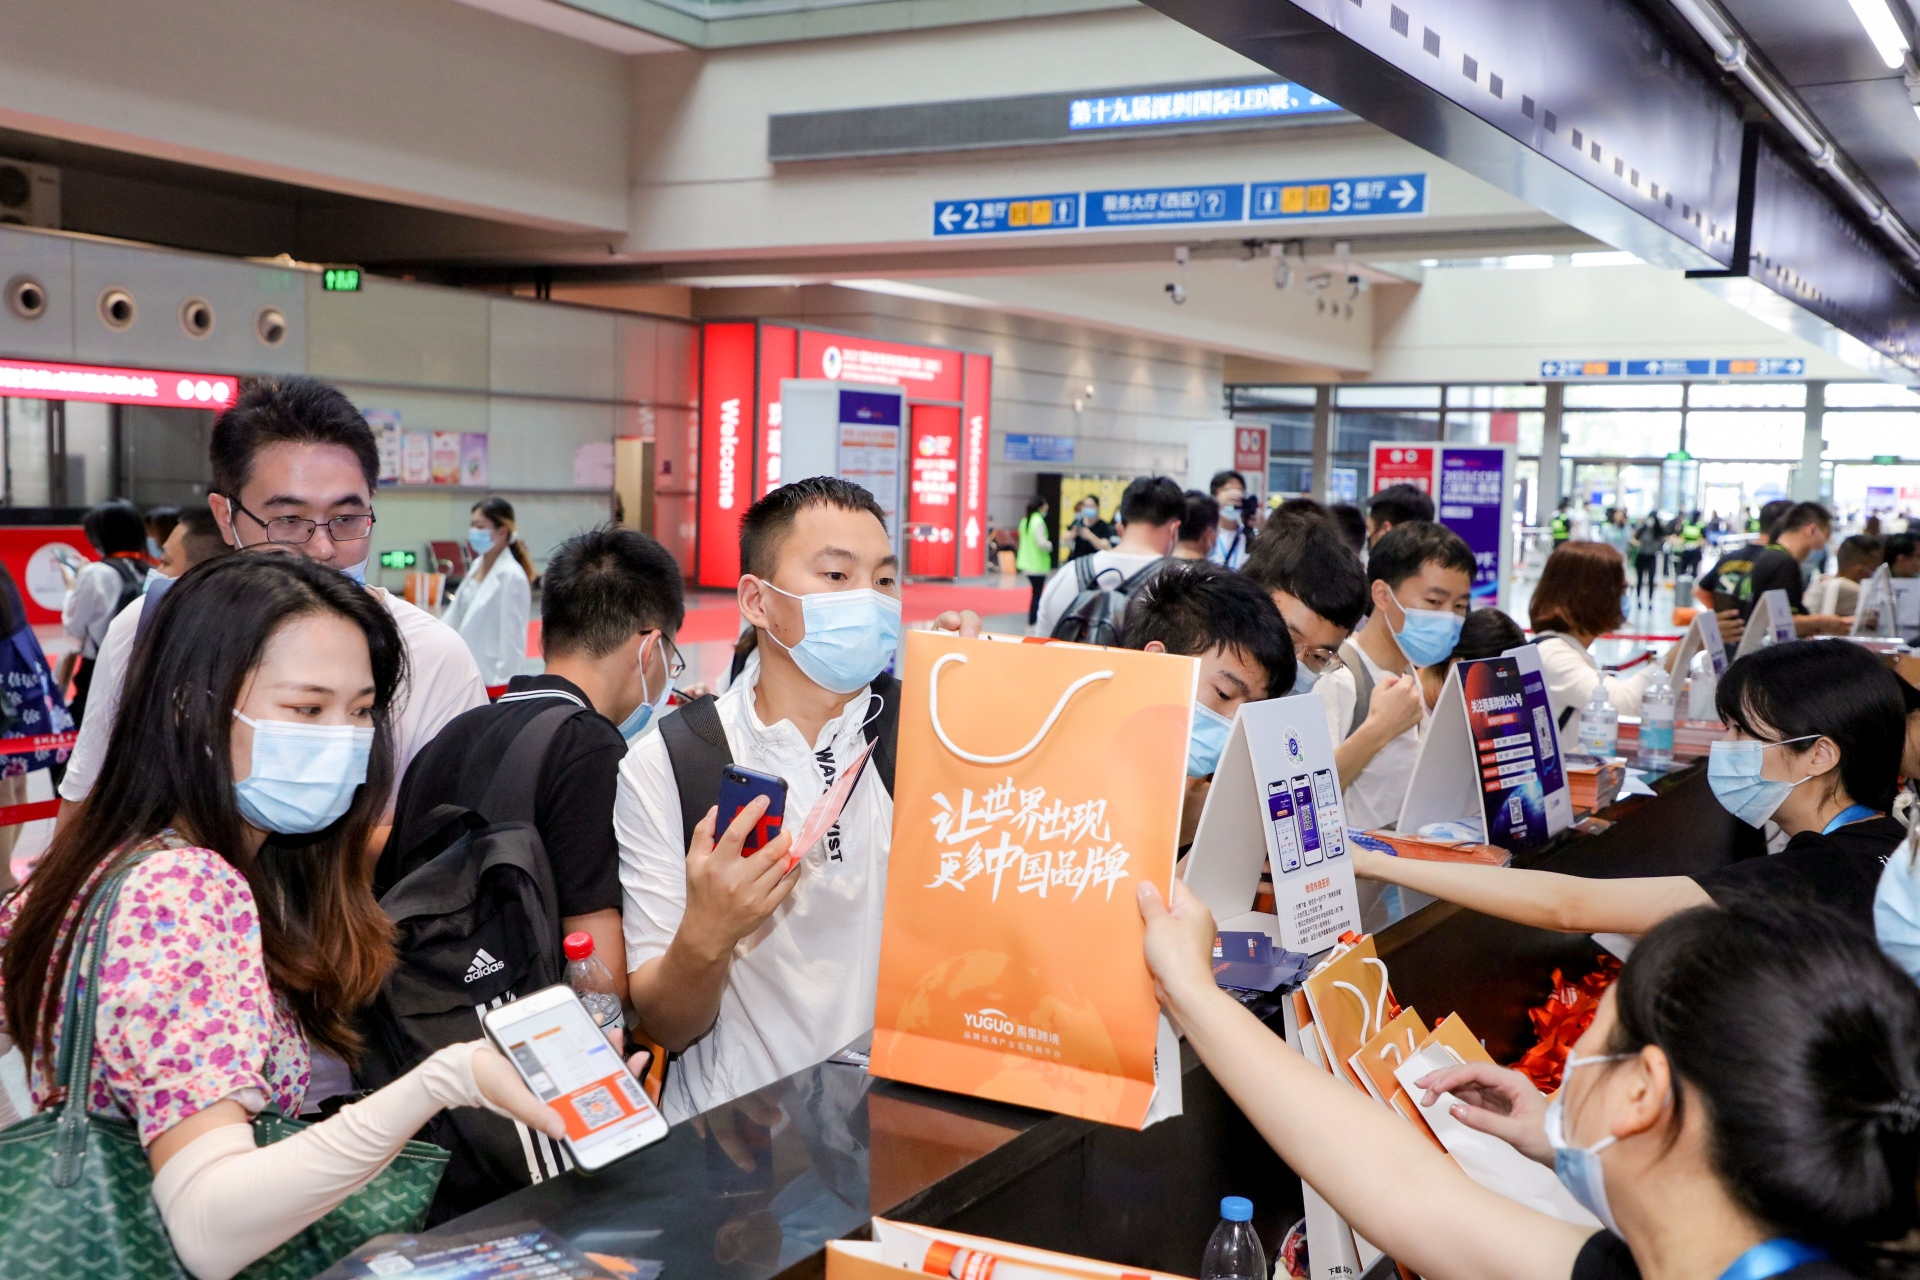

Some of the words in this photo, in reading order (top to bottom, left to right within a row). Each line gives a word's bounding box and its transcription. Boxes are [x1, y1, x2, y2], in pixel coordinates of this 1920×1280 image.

[1332, 182, 1351, 212] 3
[963, 203, 979, 229] 2
[719, 398, 740, 509] Welcome
[930, 776, 1111, 846] 让世界出现
[923, 831, 1131, 904] 更多中国品牌
[464, 961, 505, 983] adidas
[964, 1013, 1014, 1035] YUGUO
[1017, 1024, 1060, 1045] 雨果跨境
[964, 1031, 1061, 1058] 品牌出海产业互联网平台
[1328, 1266, 1342, 1275] 下载
